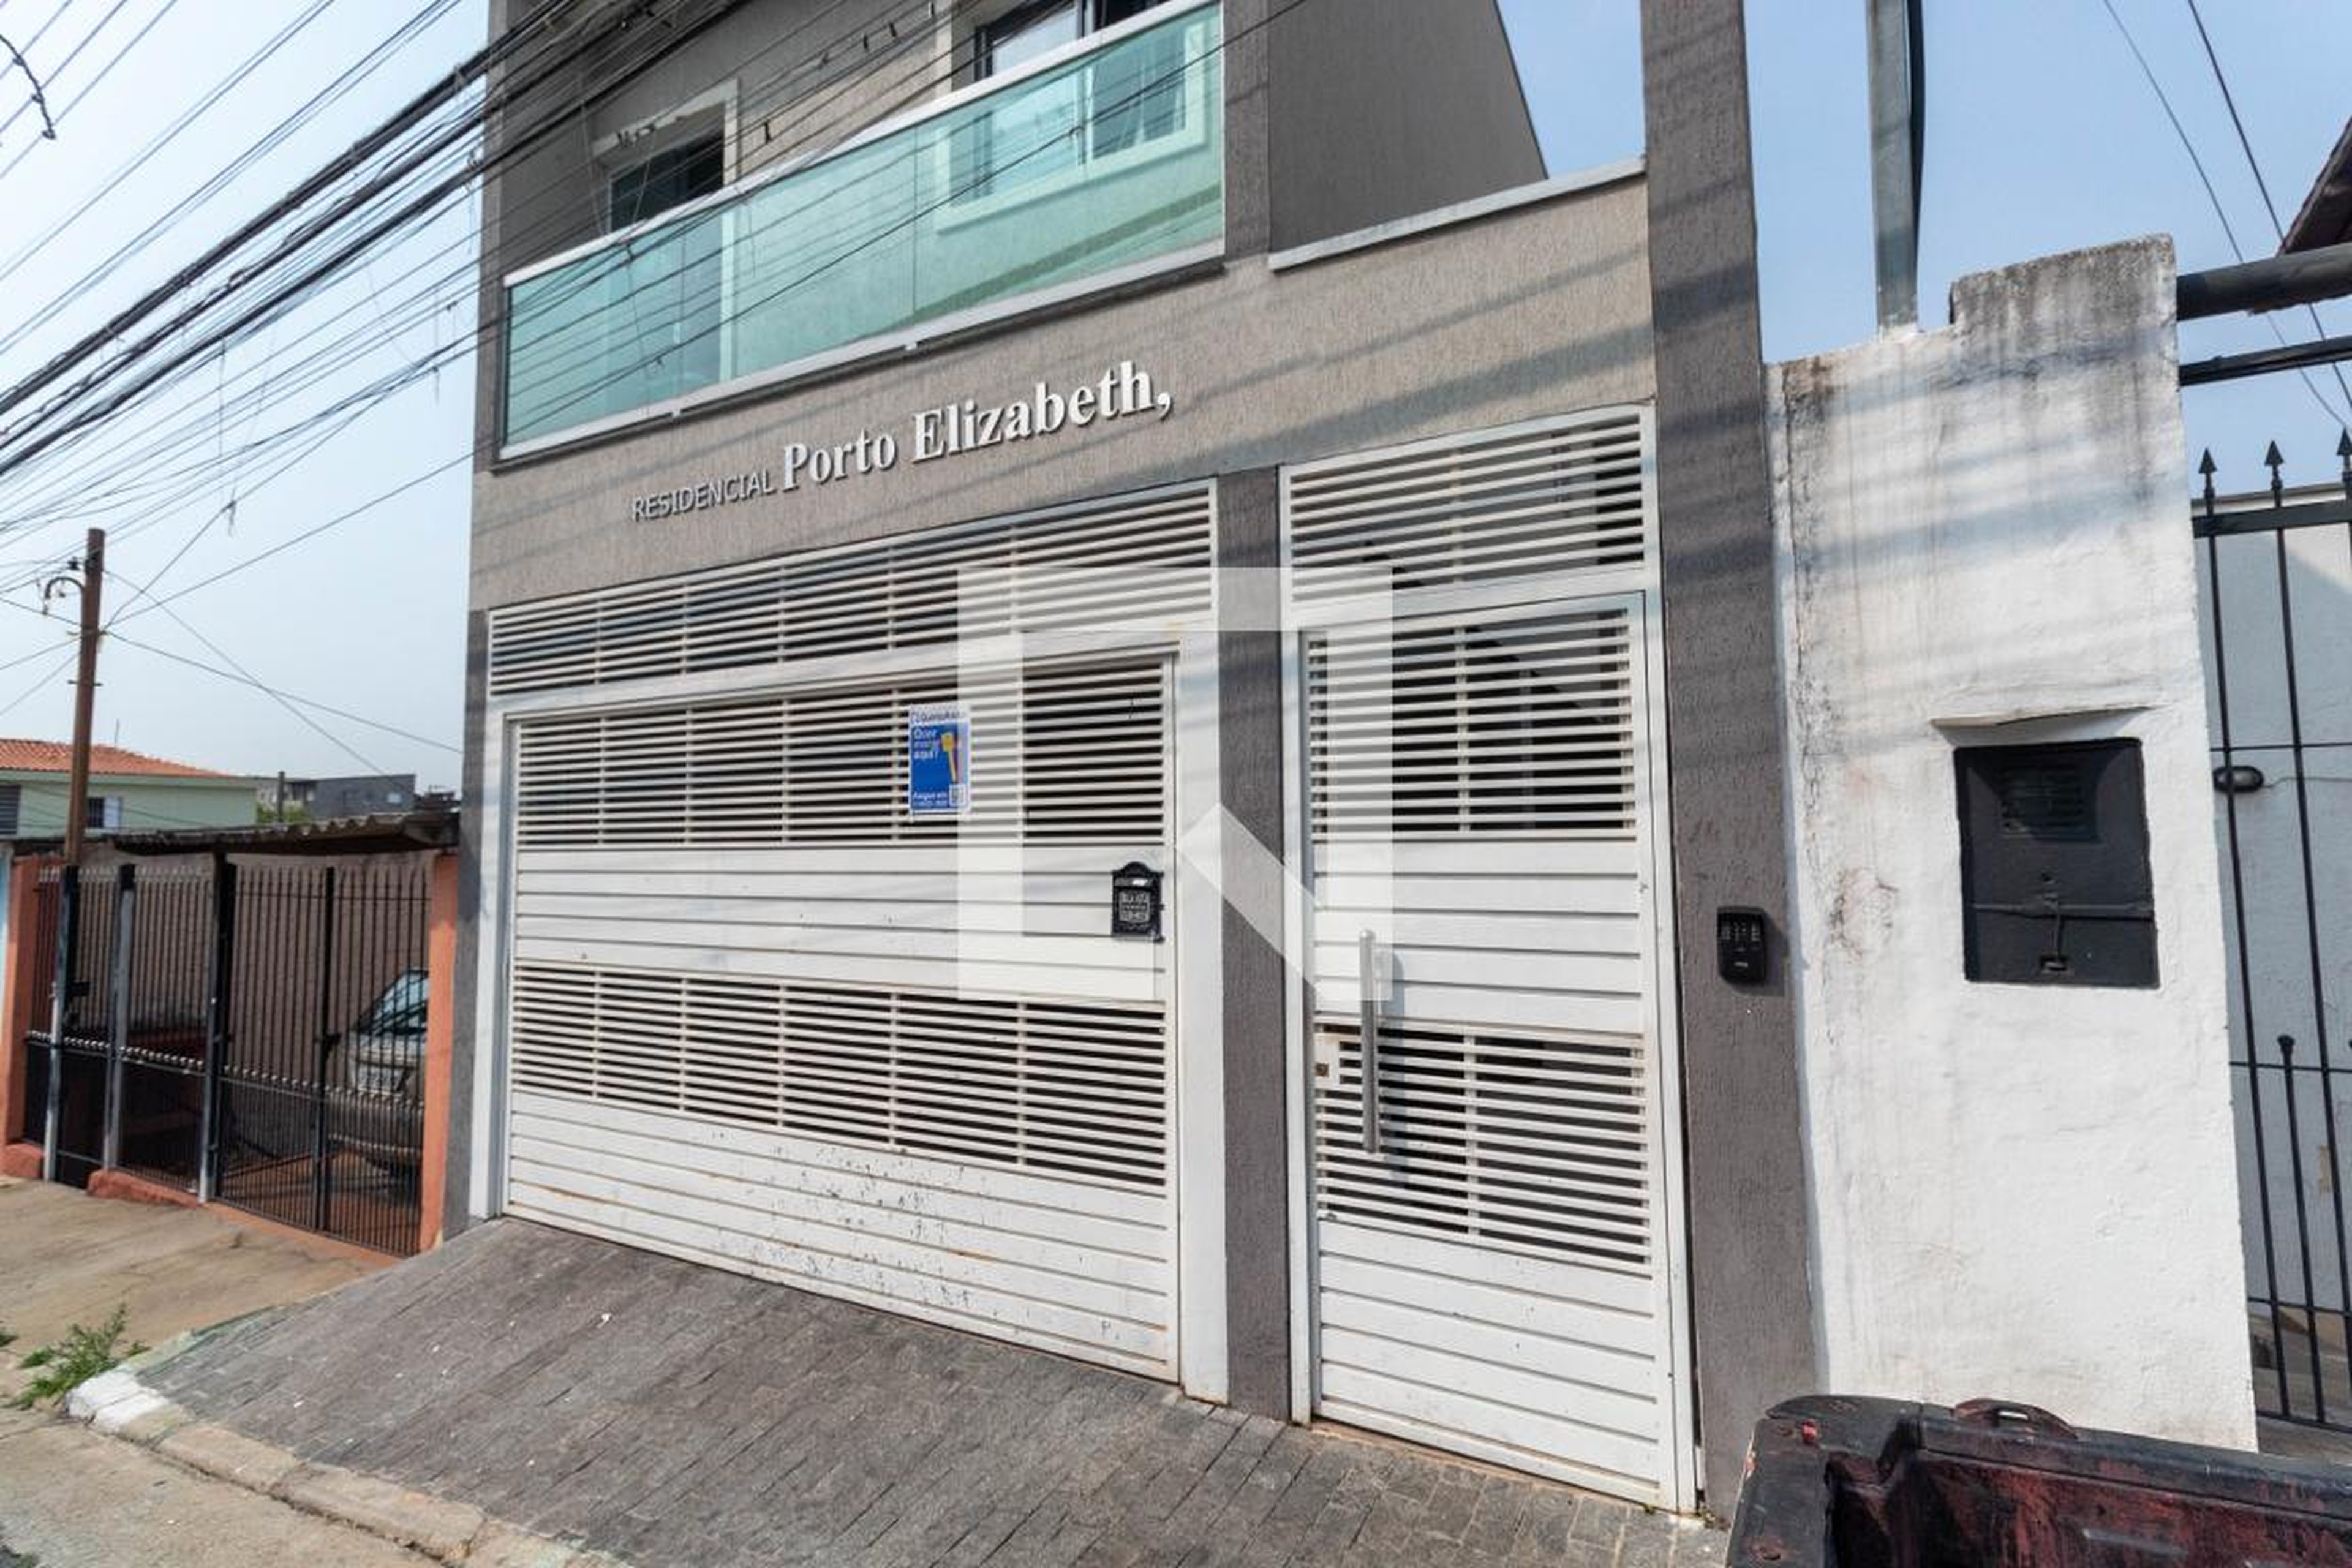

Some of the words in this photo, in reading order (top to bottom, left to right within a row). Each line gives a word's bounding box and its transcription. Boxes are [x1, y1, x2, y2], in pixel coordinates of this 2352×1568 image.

[632, 469, 775, 521] RESIDENCIAL
[783, 429, 896, 492] Porto
[913, 360, 1172, 464] Elizabeth,
